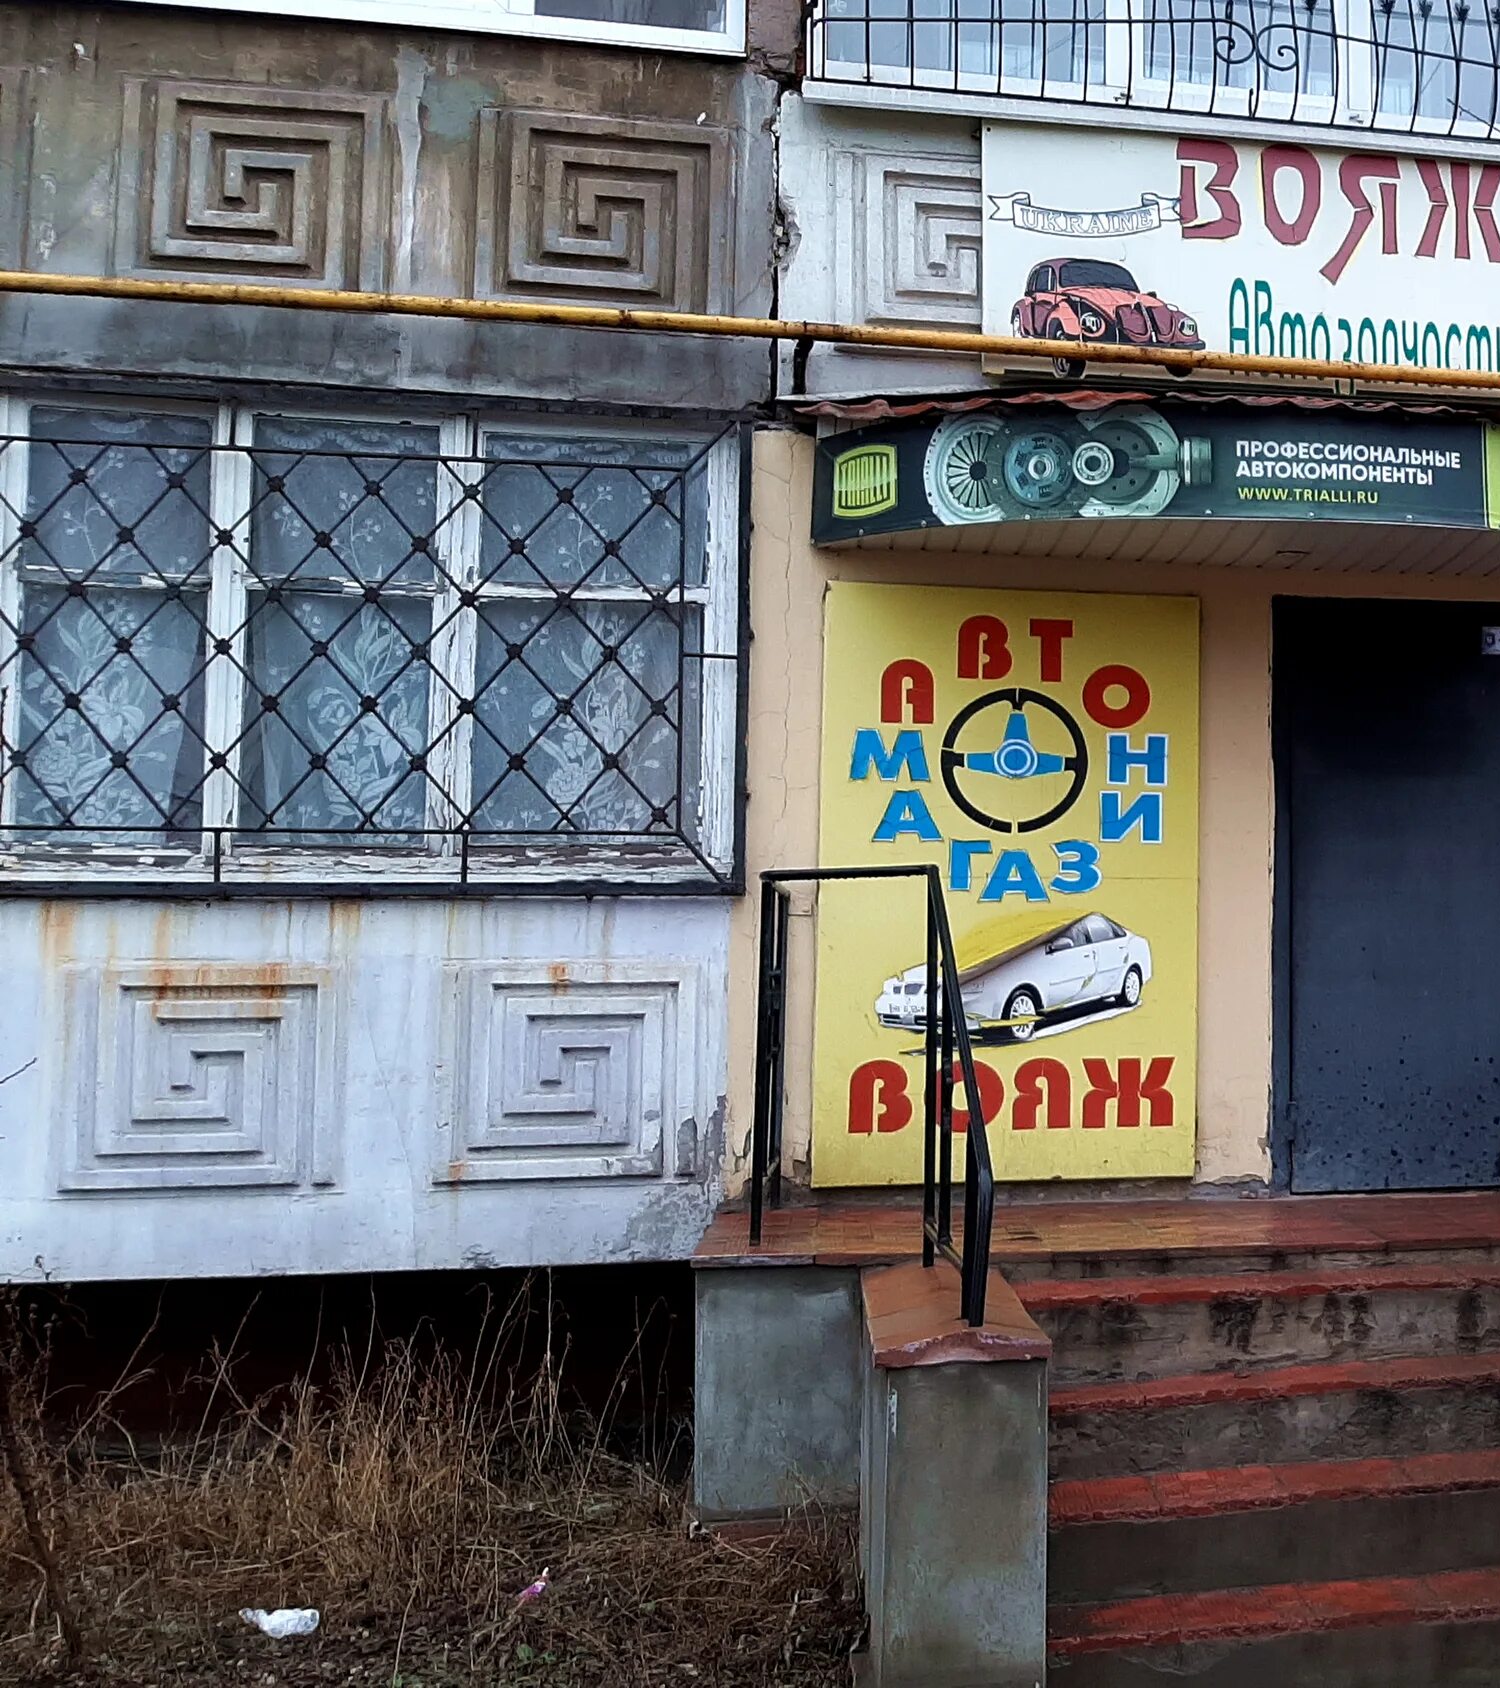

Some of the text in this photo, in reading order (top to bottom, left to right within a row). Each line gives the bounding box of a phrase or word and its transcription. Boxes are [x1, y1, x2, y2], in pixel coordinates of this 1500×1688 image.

[1020, 207, 1154, 234] UKRAINE
[1236, 440, 1461, 469] ПРОФЕССИОНАЛЬНЫЕ
[1236, 461, 1433, 486] АВТОКОМПОНЕНТЫ
[1238, 487, 1379, 505] WWW.TRIALLI.RU
[880, 615, 1151, 728] АВТО
[848, 1056, 1176, 1134] ВОЯЖ
